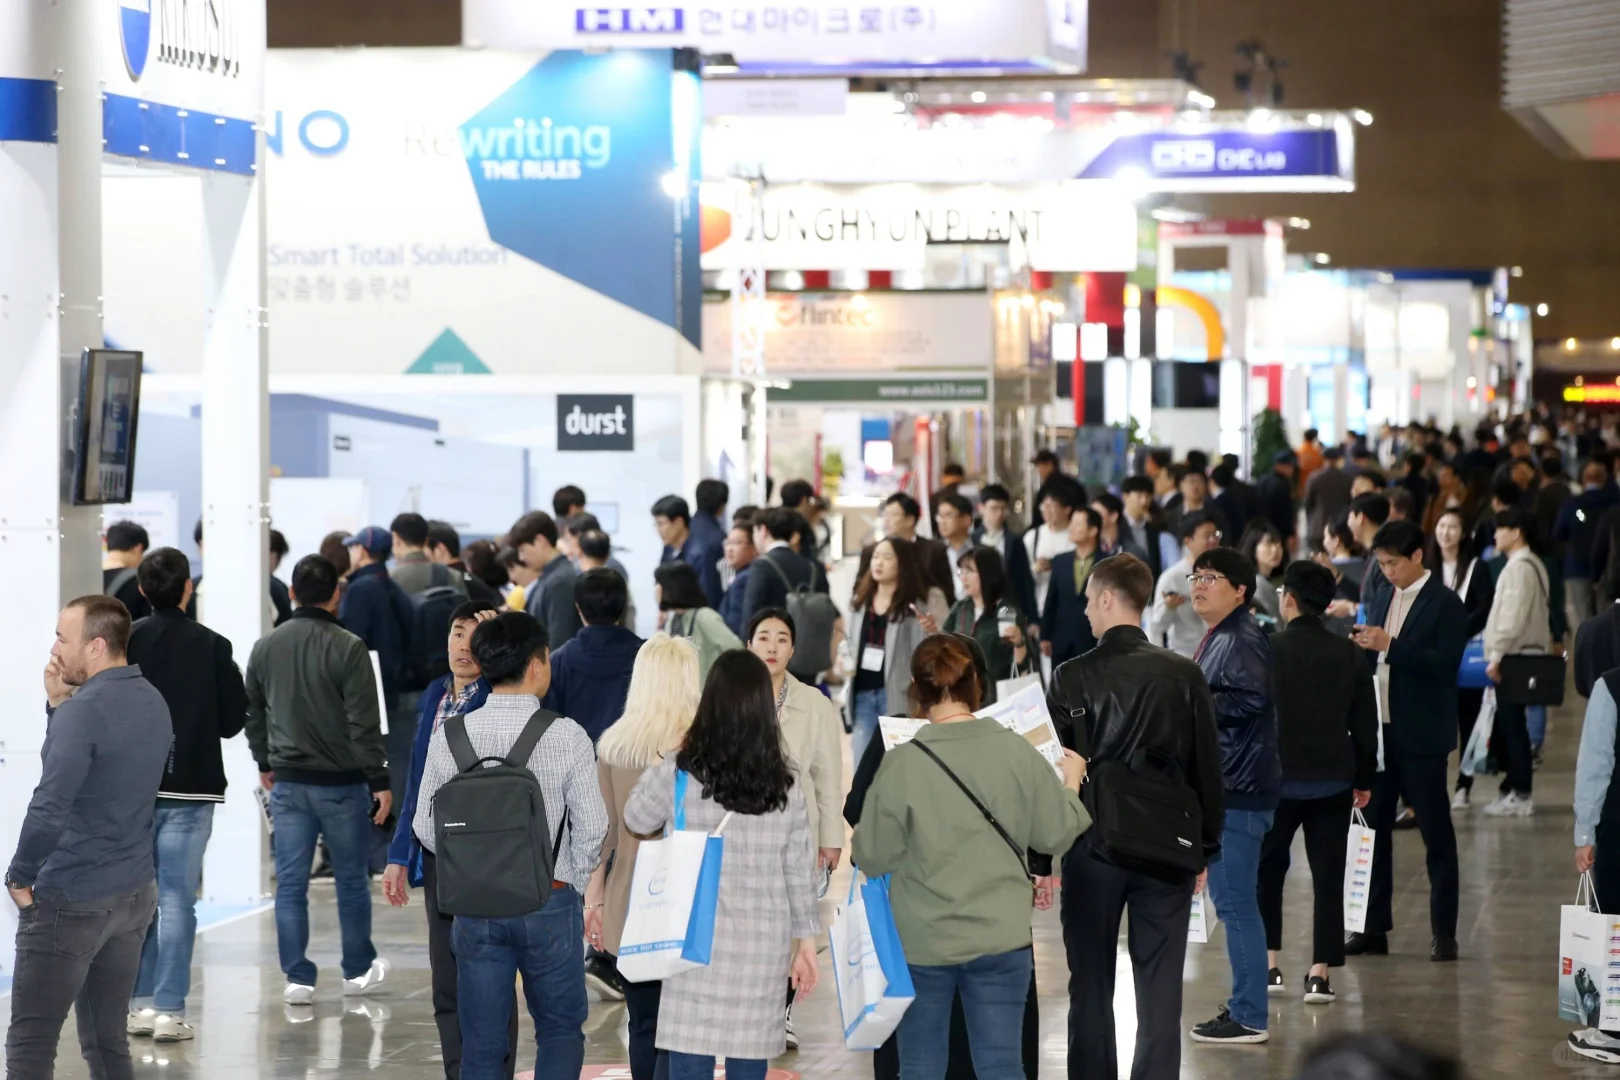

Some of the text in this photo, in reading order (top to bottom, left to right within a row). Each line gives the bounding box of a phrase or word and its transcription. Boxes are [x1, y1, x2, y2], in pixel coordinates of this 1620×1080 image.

[404, 117, 611, 168] Rewriting
[482, 160, 581, 180] THE RULES
[268, 242, 508, 266] Smart Total Solution
[344, 276, 411, 303] 솔루션
[565, 404, 627, 435] durst
